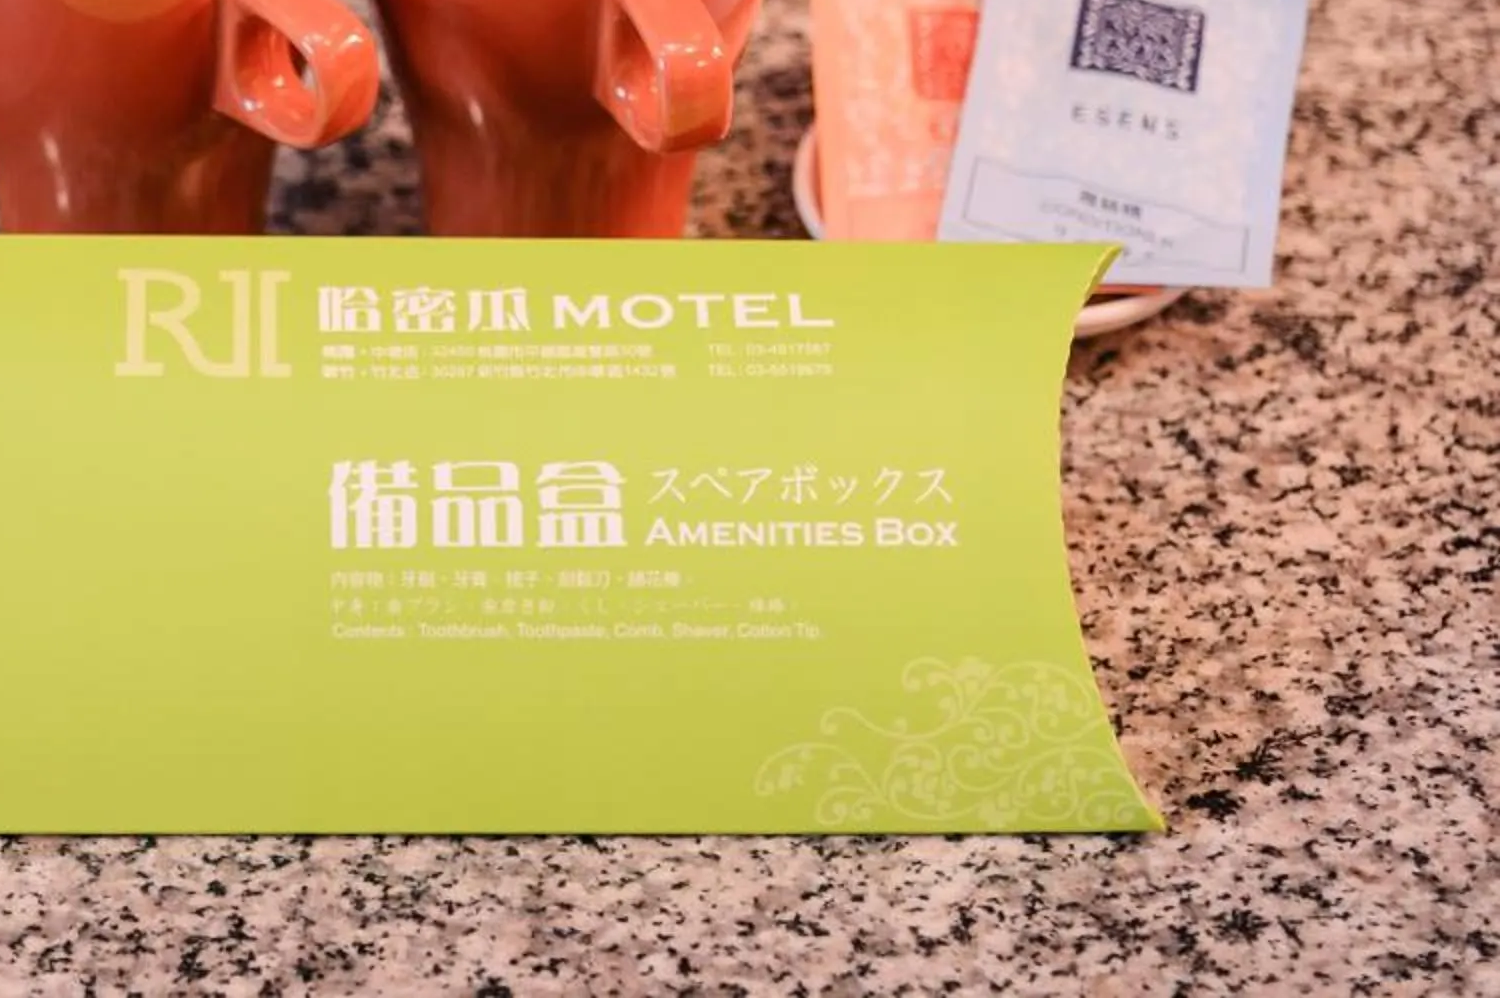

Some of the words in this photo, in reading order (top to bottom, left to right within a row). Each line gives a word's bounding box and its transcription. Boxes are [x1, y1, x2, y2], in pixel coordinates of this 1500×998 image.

[317, 285, 532, 333] 哈密瓜
[552, 293, 836, 330] MOTEL
[329, 459, 628, 549] 備品盒
[647, 462, 953, 504] スペアボックス
[644, 517, 864, 547] AMENITIES
